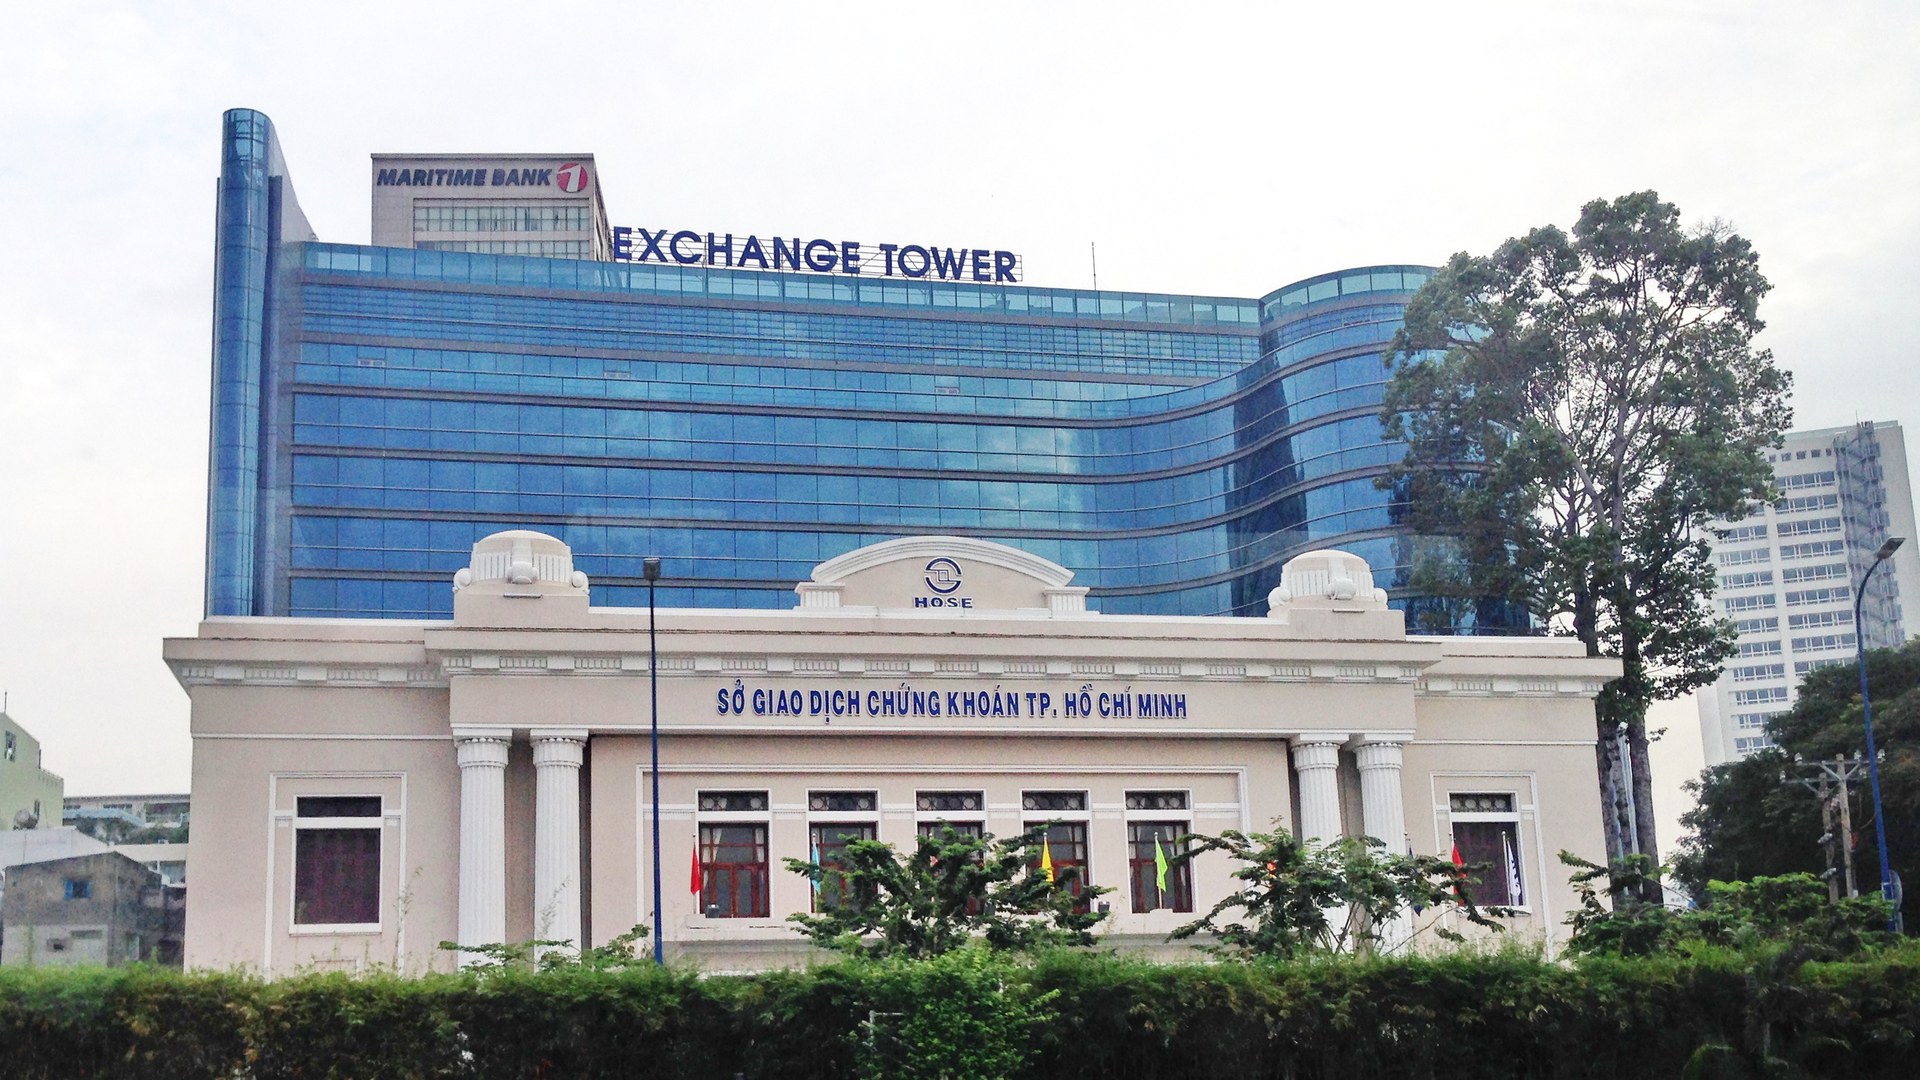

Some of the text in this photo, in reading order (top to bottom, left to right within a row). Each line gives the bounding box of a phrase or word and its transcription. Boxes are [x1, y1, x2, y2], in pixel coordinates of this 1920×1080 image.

[377, 169, 487, 186] MARITIME
[491, 169, 552, 186] BANK
[613, 226, 1017, 282] EXCHANGE TOWER
[914, 596, 973, 609] HOSE
[717, 678, 1188, 723] SỞ GIAO DỊCH CHỨNG KHOÁN TP. HỒ CHÍ MINH
